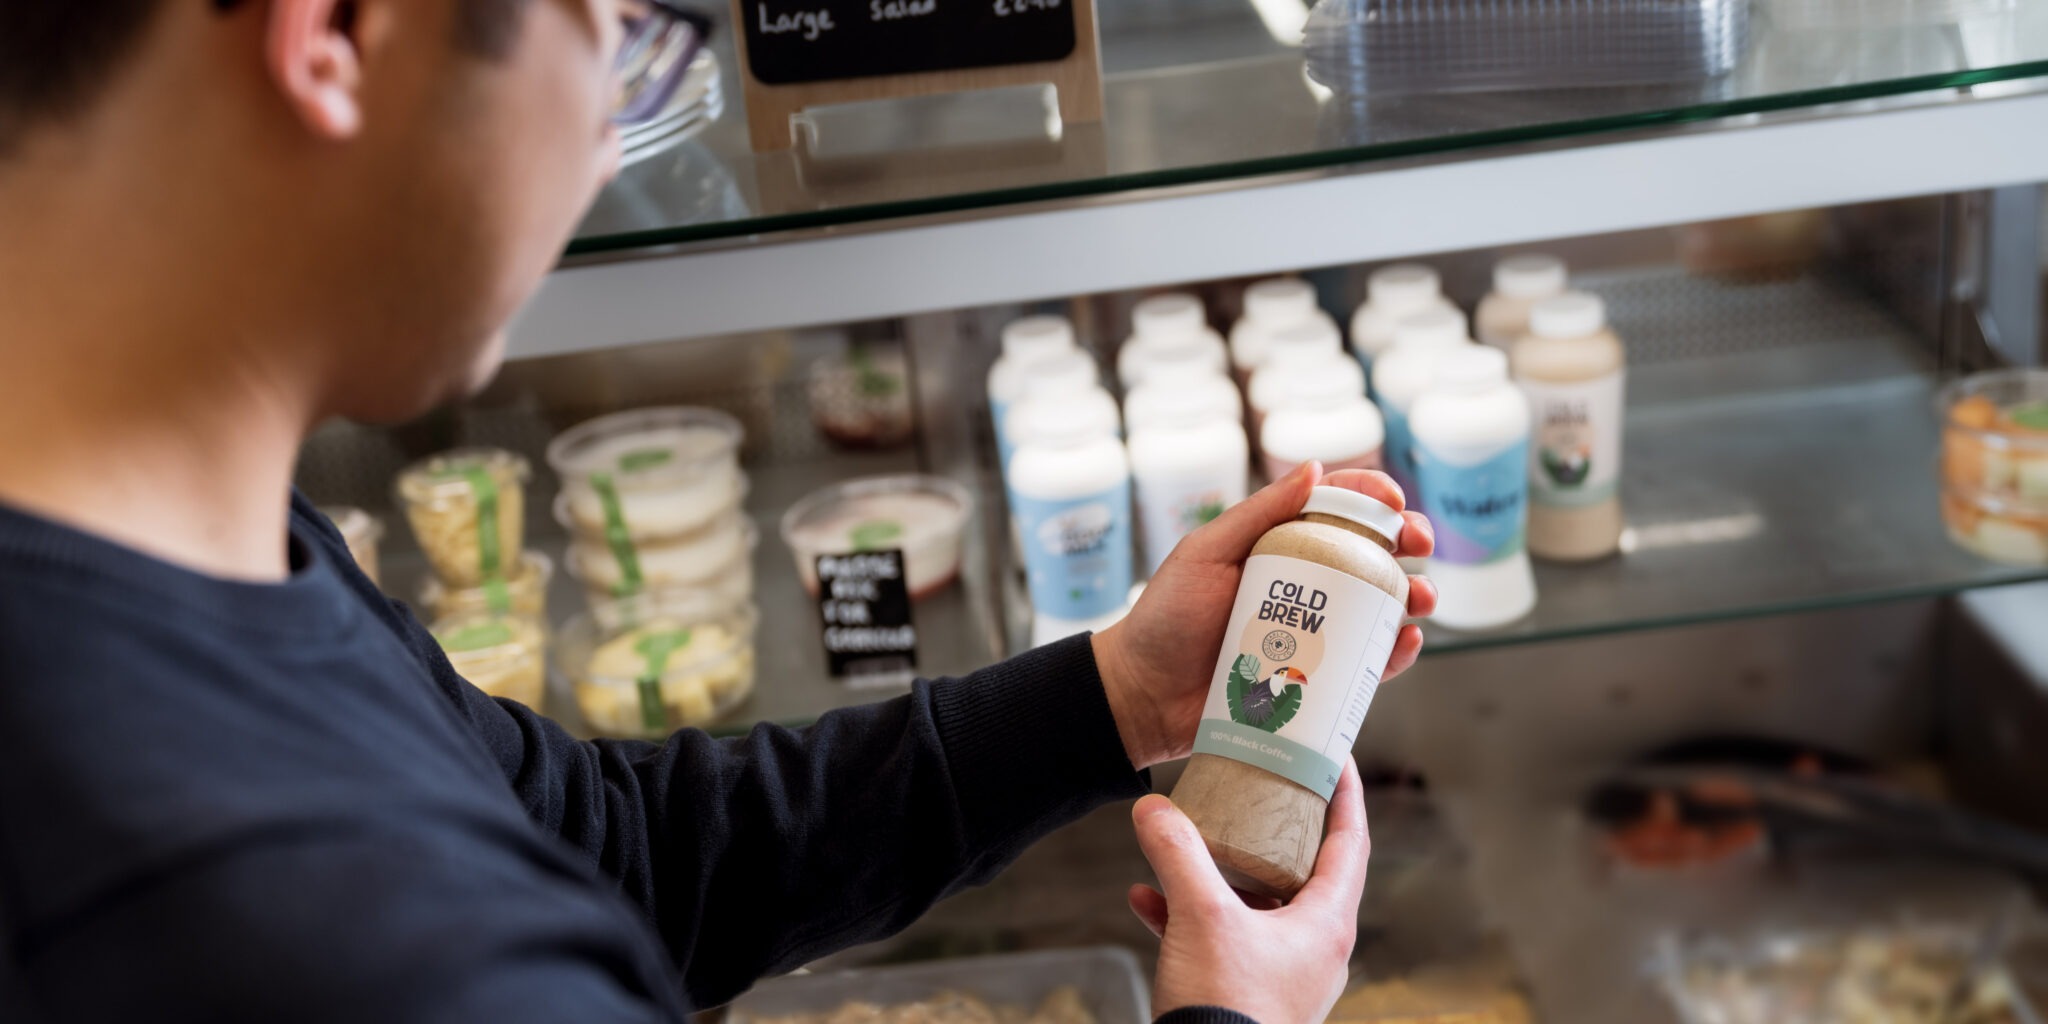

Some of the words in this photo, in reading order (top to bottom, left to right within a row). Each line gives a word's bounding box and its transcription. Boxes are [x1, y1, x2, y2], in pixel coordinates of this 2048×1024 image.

[757, 4, 835, 40] Large
[1268, 579, 1328, 612] COLD
[1258, 600, 1326, 634] BREW
[1232, 735, 1258, 750] Black
[1260, 743, 1293, 763] Coffee
